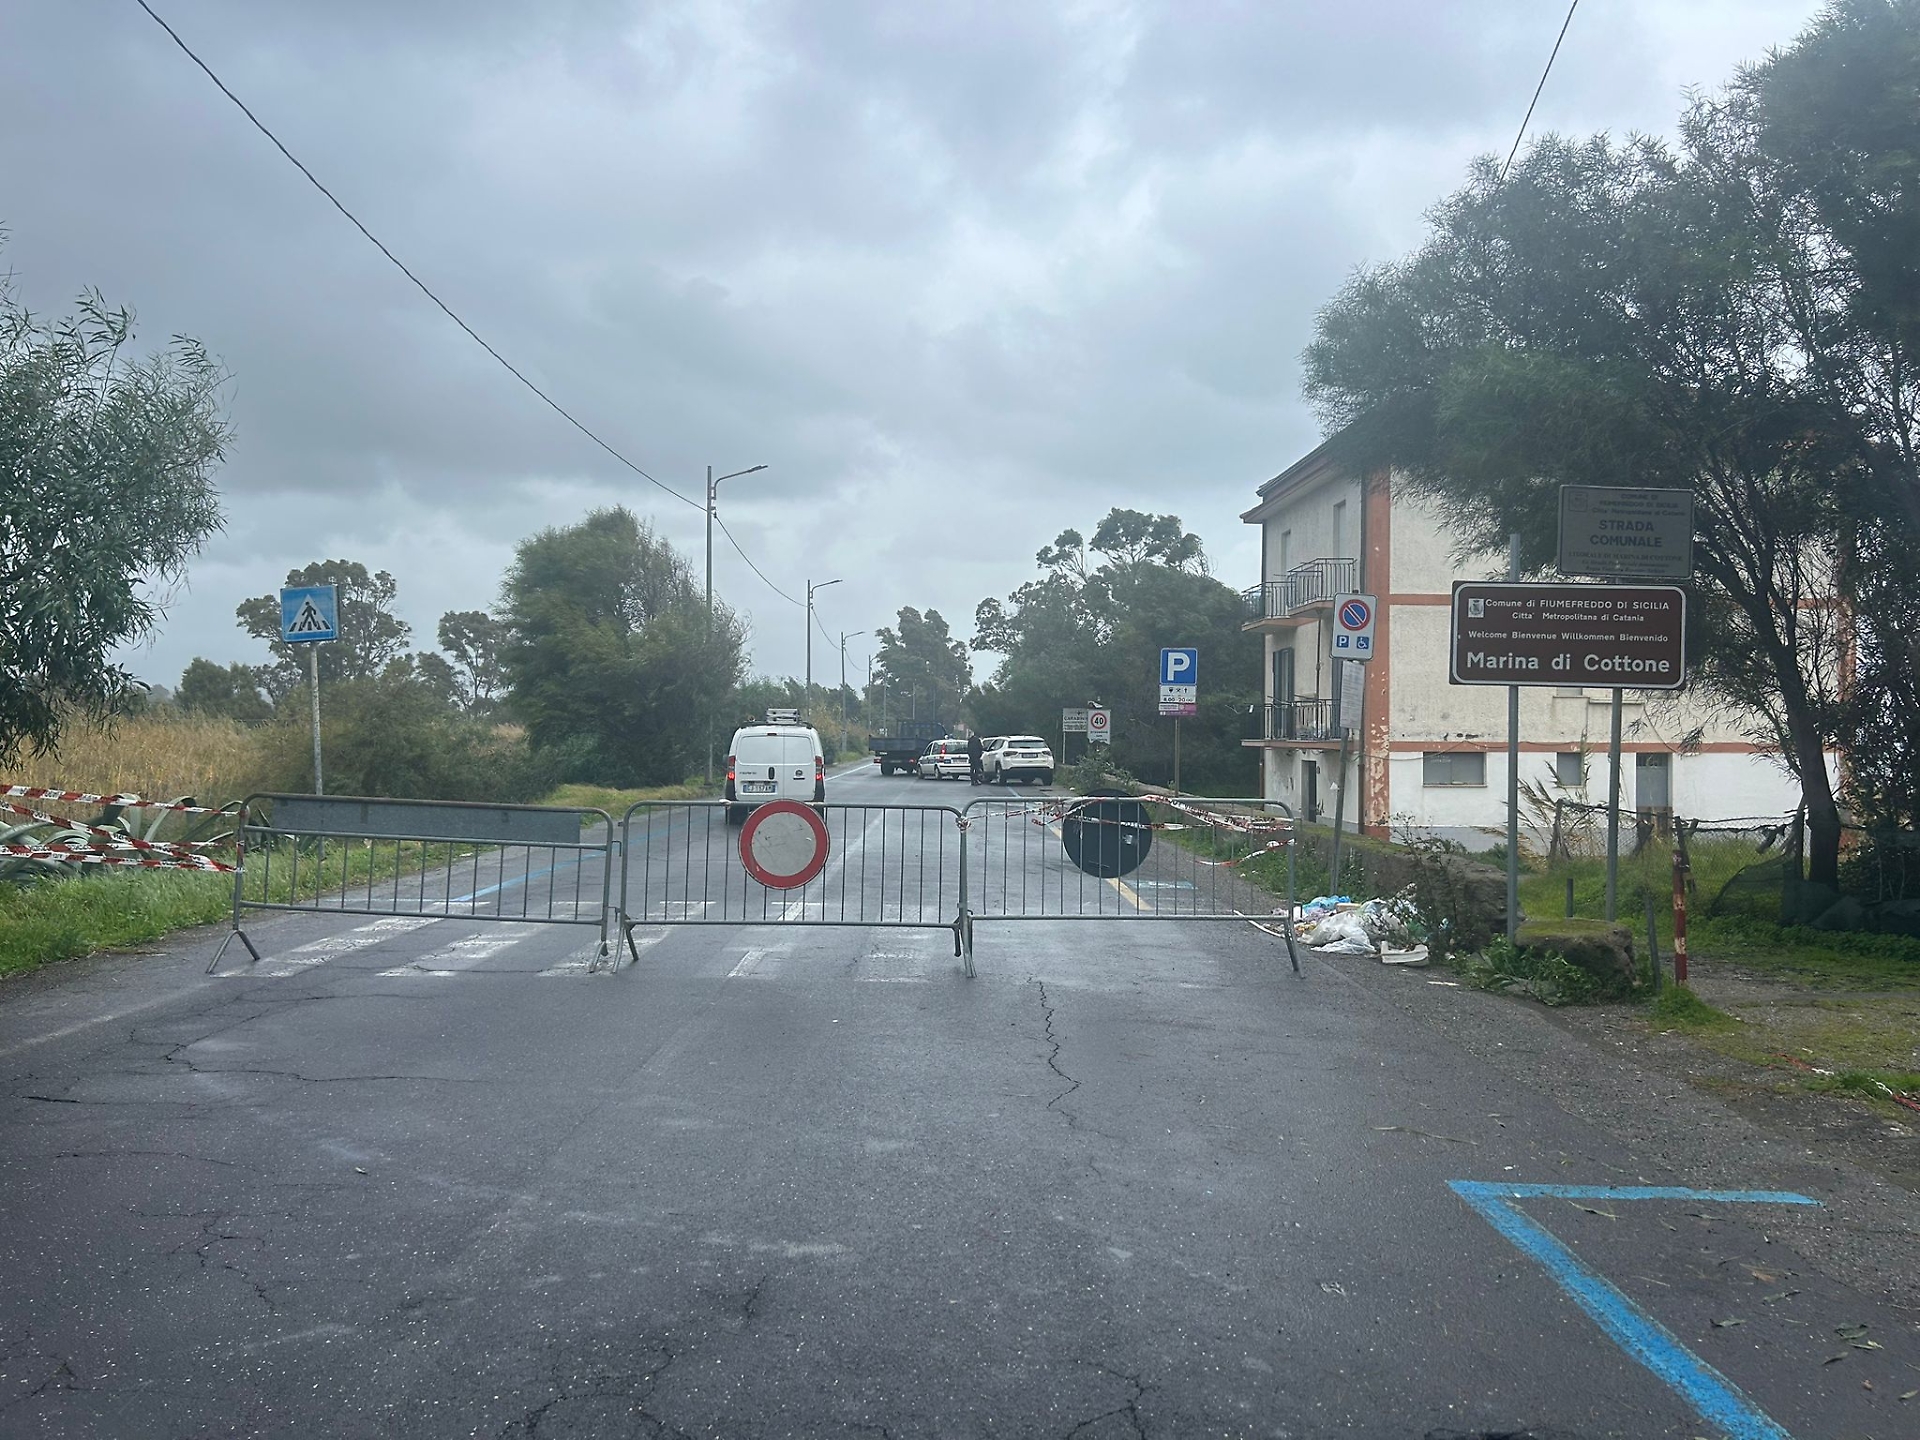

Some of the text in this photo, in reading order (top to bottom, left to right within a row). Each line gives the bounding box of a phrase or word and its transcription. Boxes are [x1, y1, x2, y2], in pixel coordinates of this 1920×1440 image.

[1598, 519, 1654, 532] STRADA
[1589, 534, 1663, 548] COMUNALE
[1485, 598, 1670, 610] Comune di FIUMEFREDDO DI SICILIA
[1542, 612, 1597, 622] Metropolitana
[1601, 613, 1609, 621] di
[1613, 614, 1644, 622] Catania
[1468, 630, 1668, 642] Welcome Bienvenue Willkommen Bienvenido
[1167, 652, 1191, 681] P
[1467, 651, 1670, 673] Marina di Cottone
[1094, 717, 1104, 725] 40
